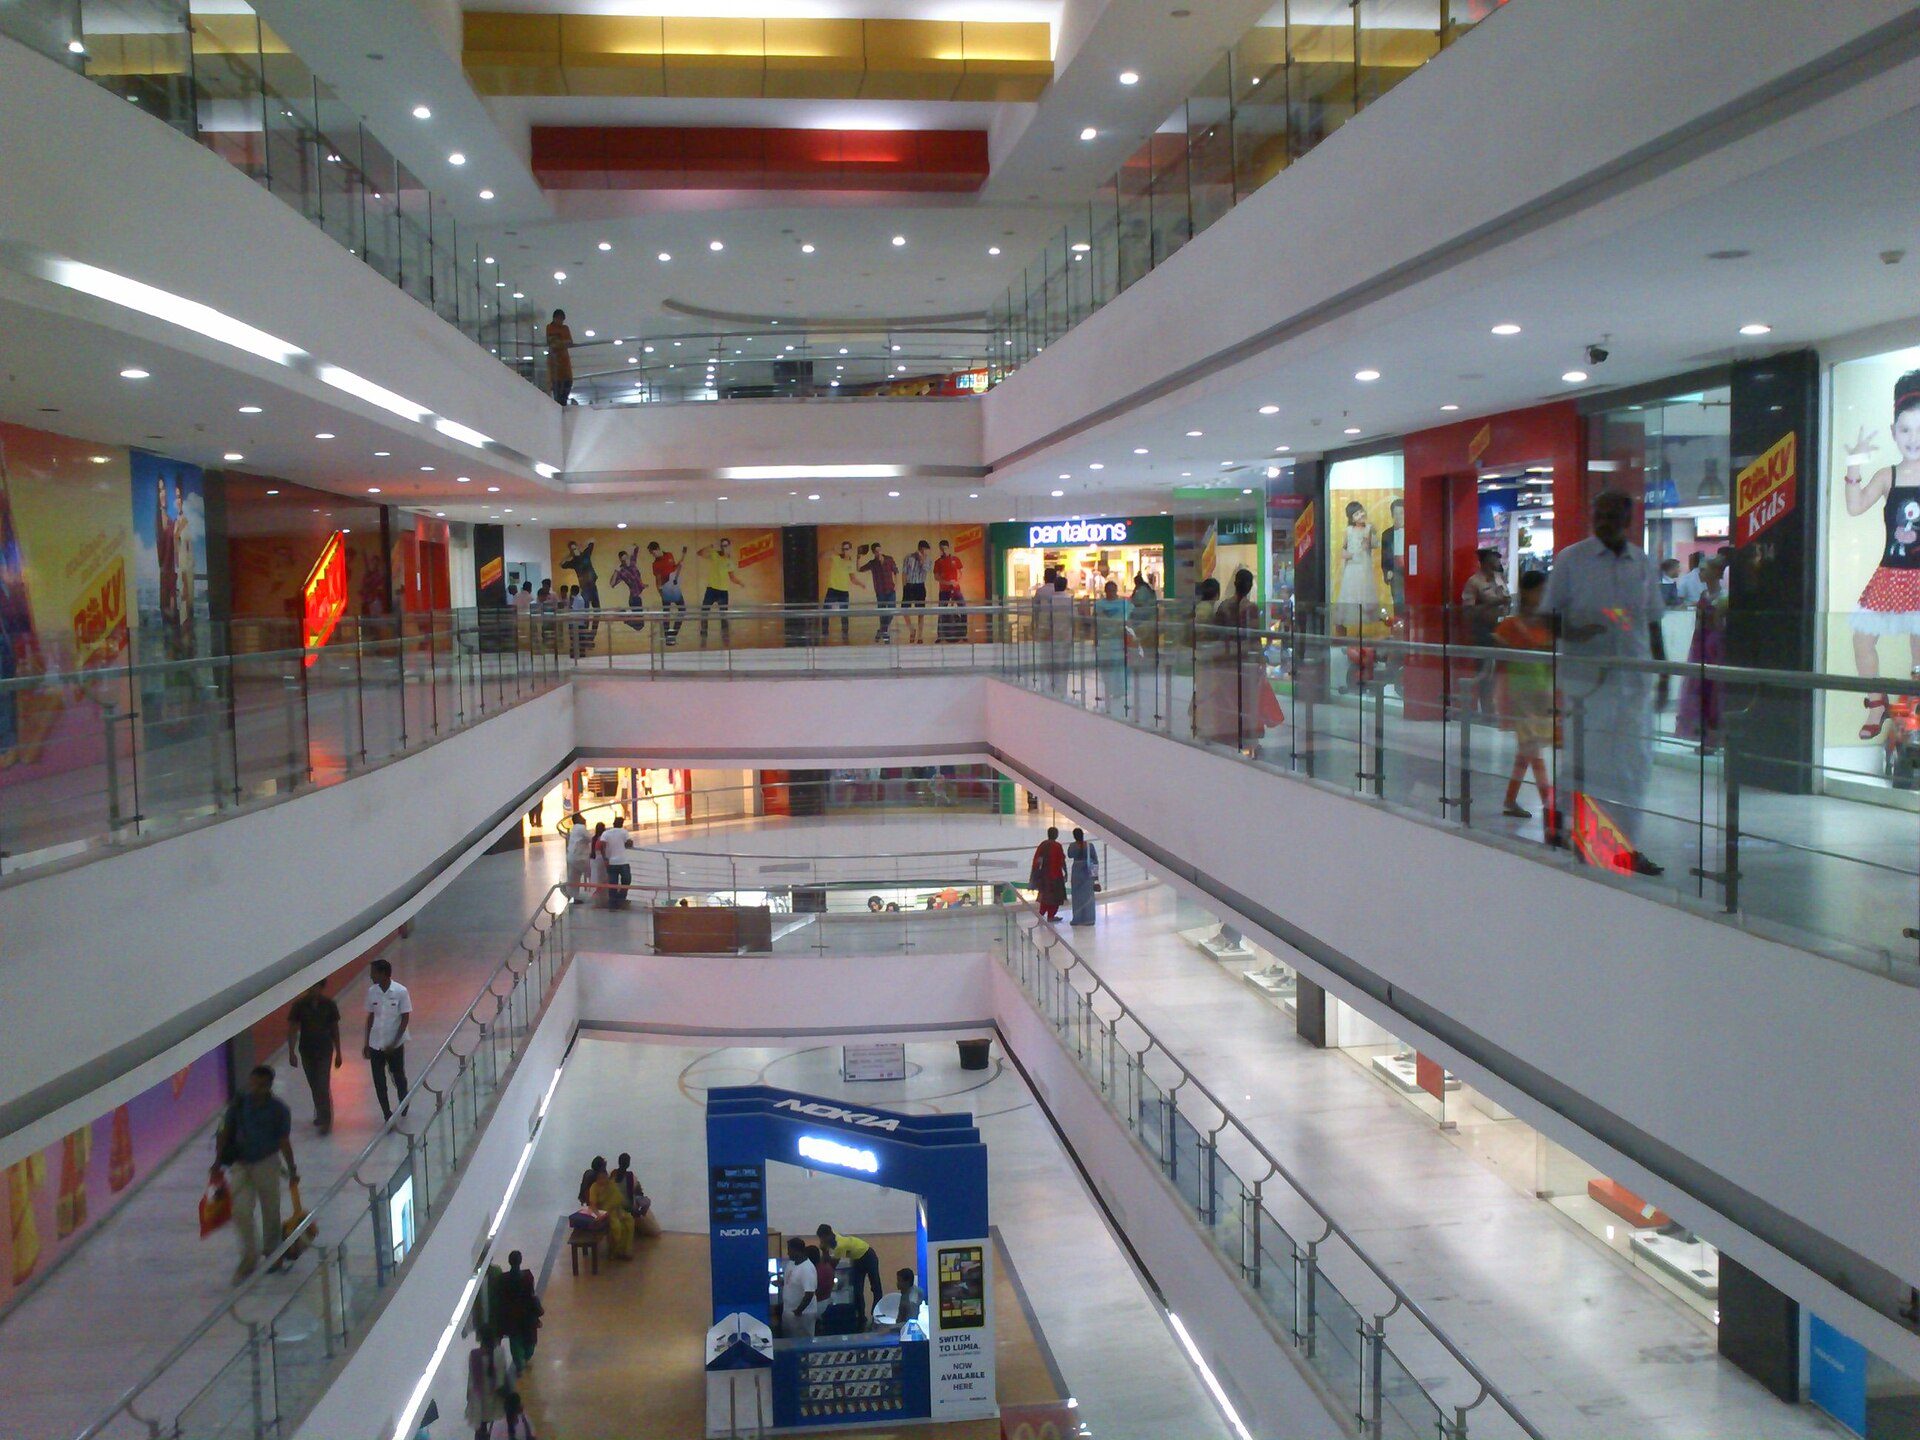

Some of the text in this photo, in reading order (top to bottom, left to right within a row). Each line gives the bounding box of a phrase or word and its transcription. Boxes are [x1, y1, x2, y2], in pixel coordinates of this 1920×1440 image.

[1748, 490, 1786, 537] Kids
[1029, 519, 1127, 548] pantaloons
[773, 1098, 900, 1132] NOKIA
[939, 1335, 971, 1343] SWITCH
[953, 1362, 973, 1370] NOW
[941, 1372, 985, 1380] AVAILABLE
[953, 1382, 974, 1390] HERE
